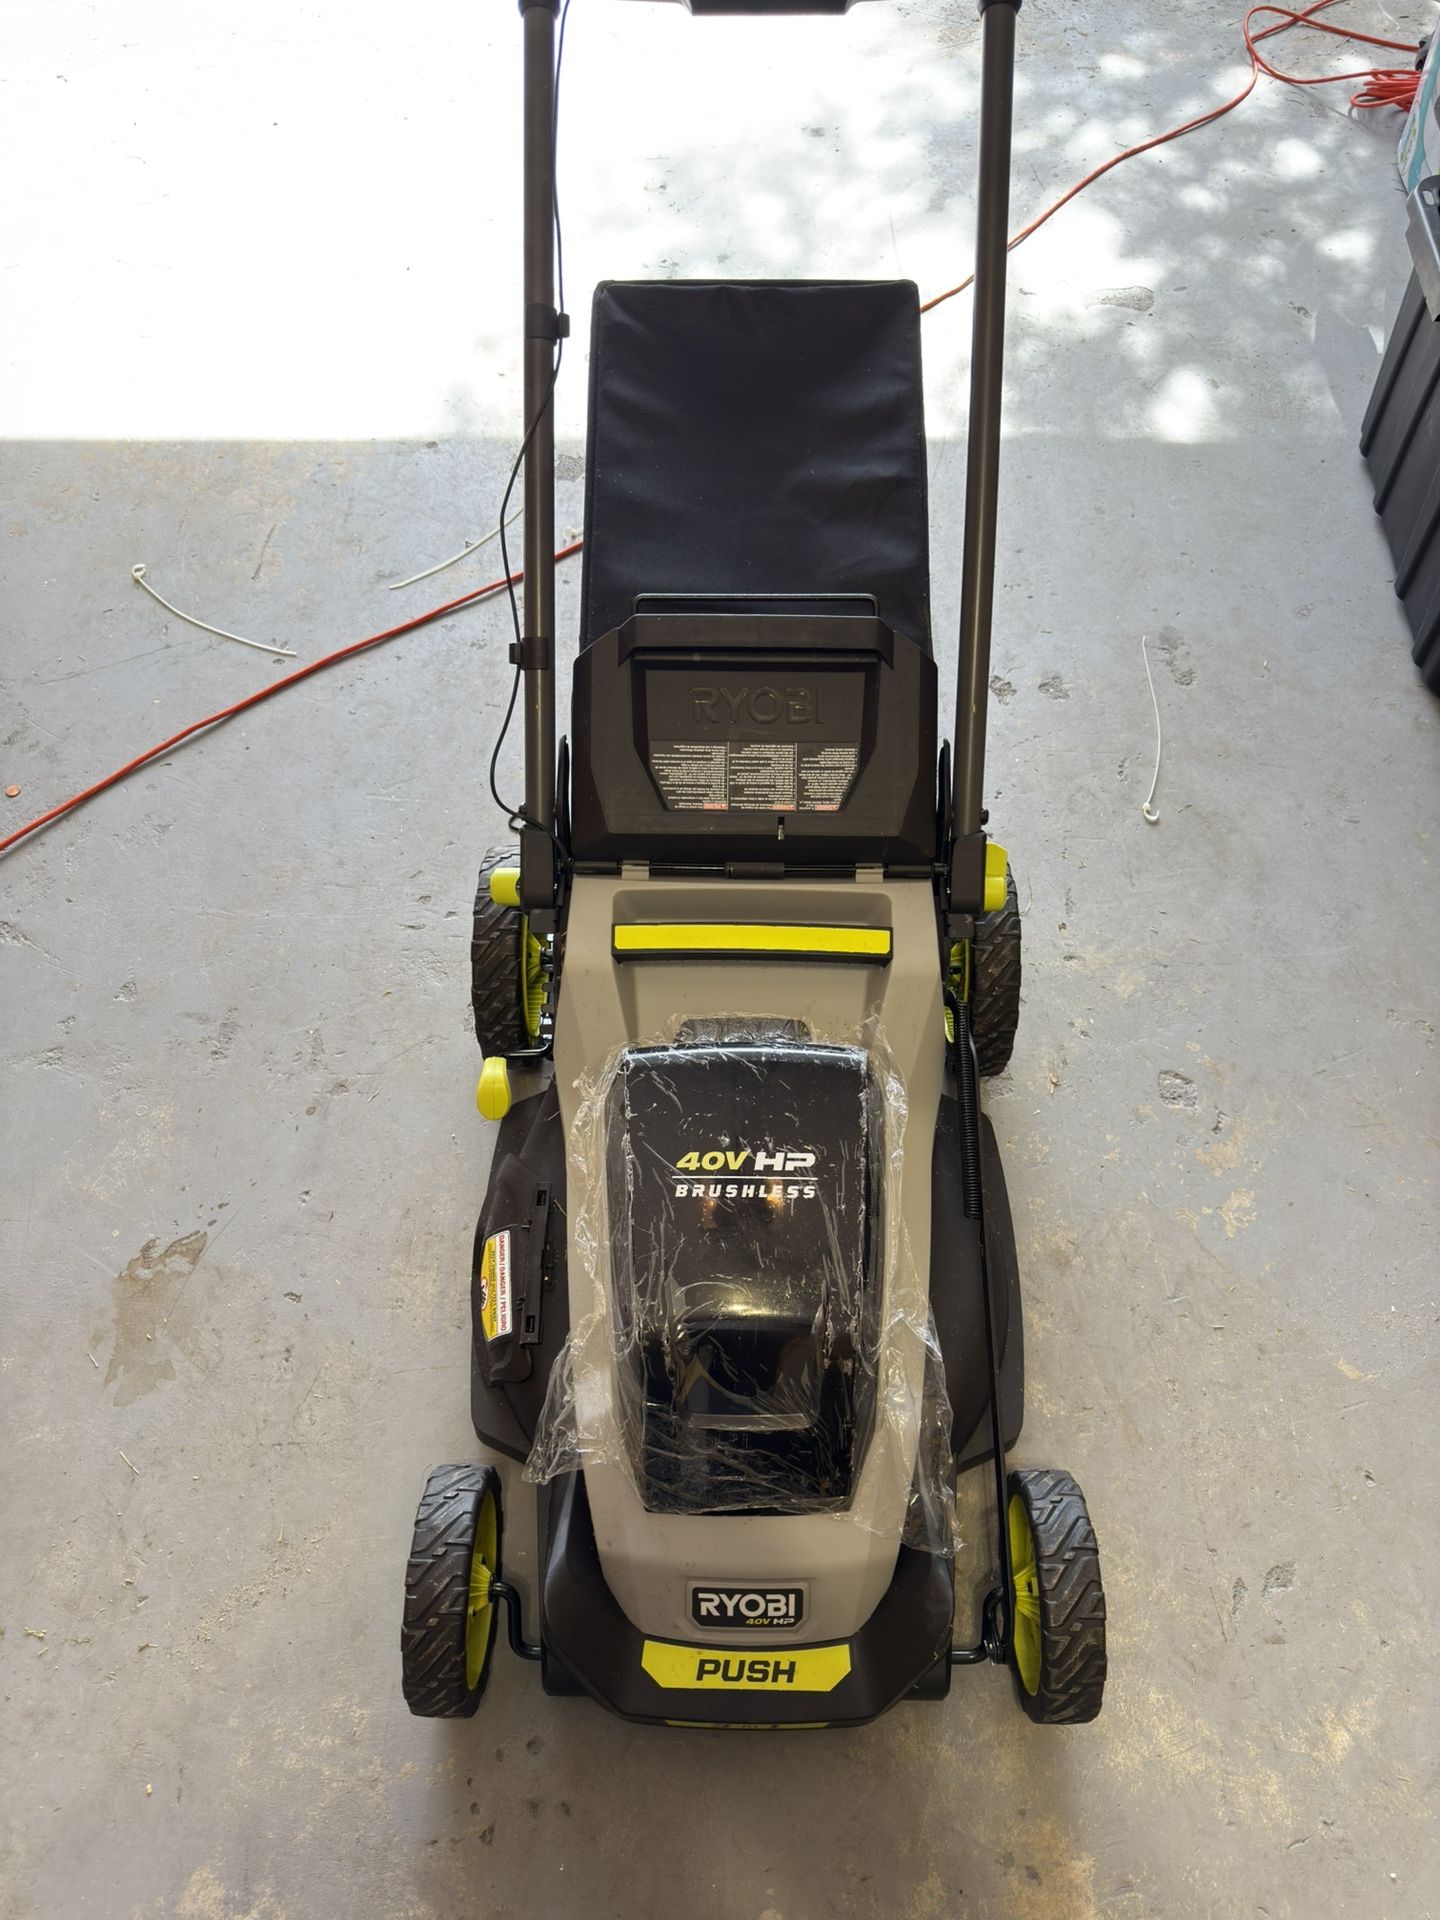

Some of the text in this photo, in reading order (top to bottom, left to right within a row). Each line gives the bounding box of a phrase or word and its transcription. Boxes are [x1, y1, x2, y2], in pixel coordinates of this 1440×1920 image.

[690, 687, 825, 724] RYOBI
[676, 1151, 816, 1171] 40V HP
[675, 1184, 816, 1199] BRUSHLESS
[698, 1592, 796, 1617] RYOBI
[696, 1658, 796, 1683] PUSH
